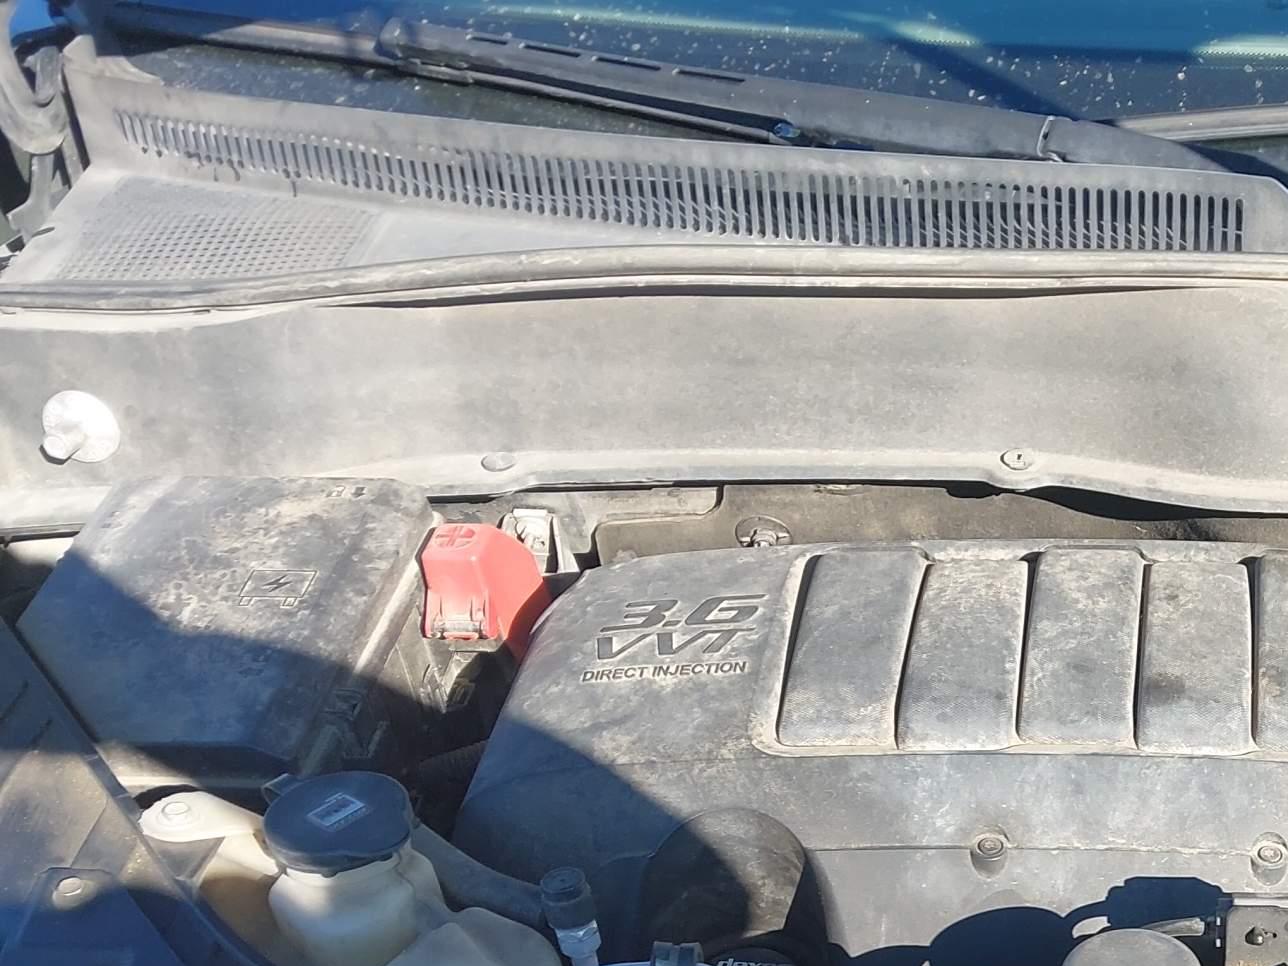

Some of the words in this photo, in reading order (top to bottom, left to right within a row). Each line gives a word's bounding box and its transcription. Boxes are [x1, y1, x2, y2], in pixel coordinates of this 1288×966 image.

[600, 593, 768, 632] 3.6
[597, 628, 756, 660] VVT
[582, 667, 649, 682] DIRECT
[653, 661, 748, 678] INJECTION
